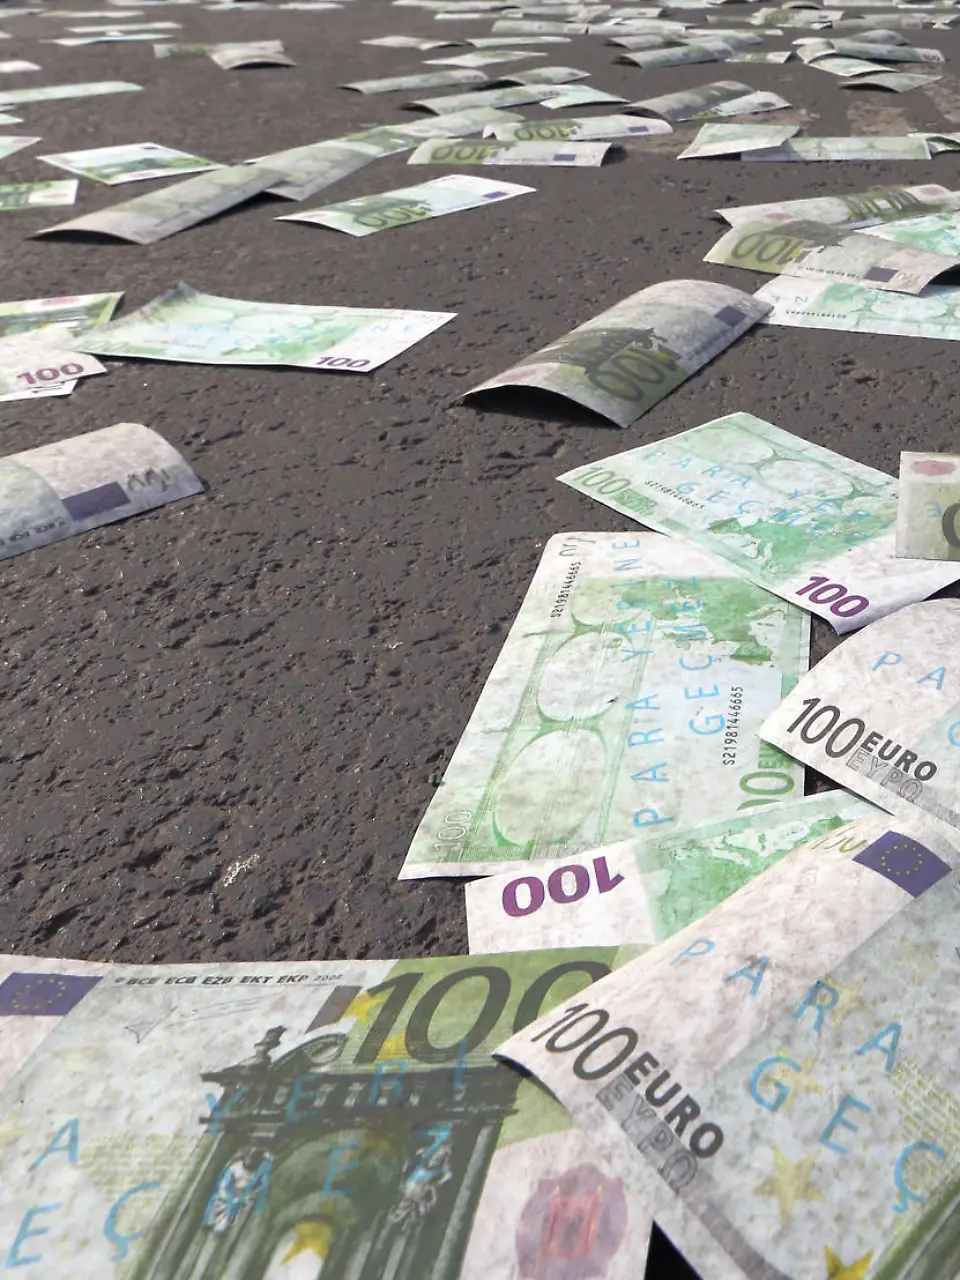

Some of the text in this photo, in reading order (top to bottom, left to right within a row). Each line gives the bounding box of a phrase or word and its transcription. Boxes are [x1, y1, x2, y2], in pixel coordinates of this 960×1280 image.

[16, 362, 84, 385] 100
[316, 355, 371, 369] 100
[573, 467, 630, 495] 100
[795, 575, 870, 618] 100
[722, 686, 744, 766] S21981446665
[786, 696, 865, 759] 100
[861, 730, 938, 782] EURO
[628, 693, 676, 830] PARA
[502, 856, 625, 917] 100
[126, 976, 160, 986] BCE
[164, 975, 197, 985] ECB
[239, 975, 269, 985] EKT
[276, 973, 309, 984] EKP
[670, 937, 902, 1073] PARA
[531, 1002, 725, 1160] 100 EURO
[5, 1122, 453, 1268] EÇMEZ
